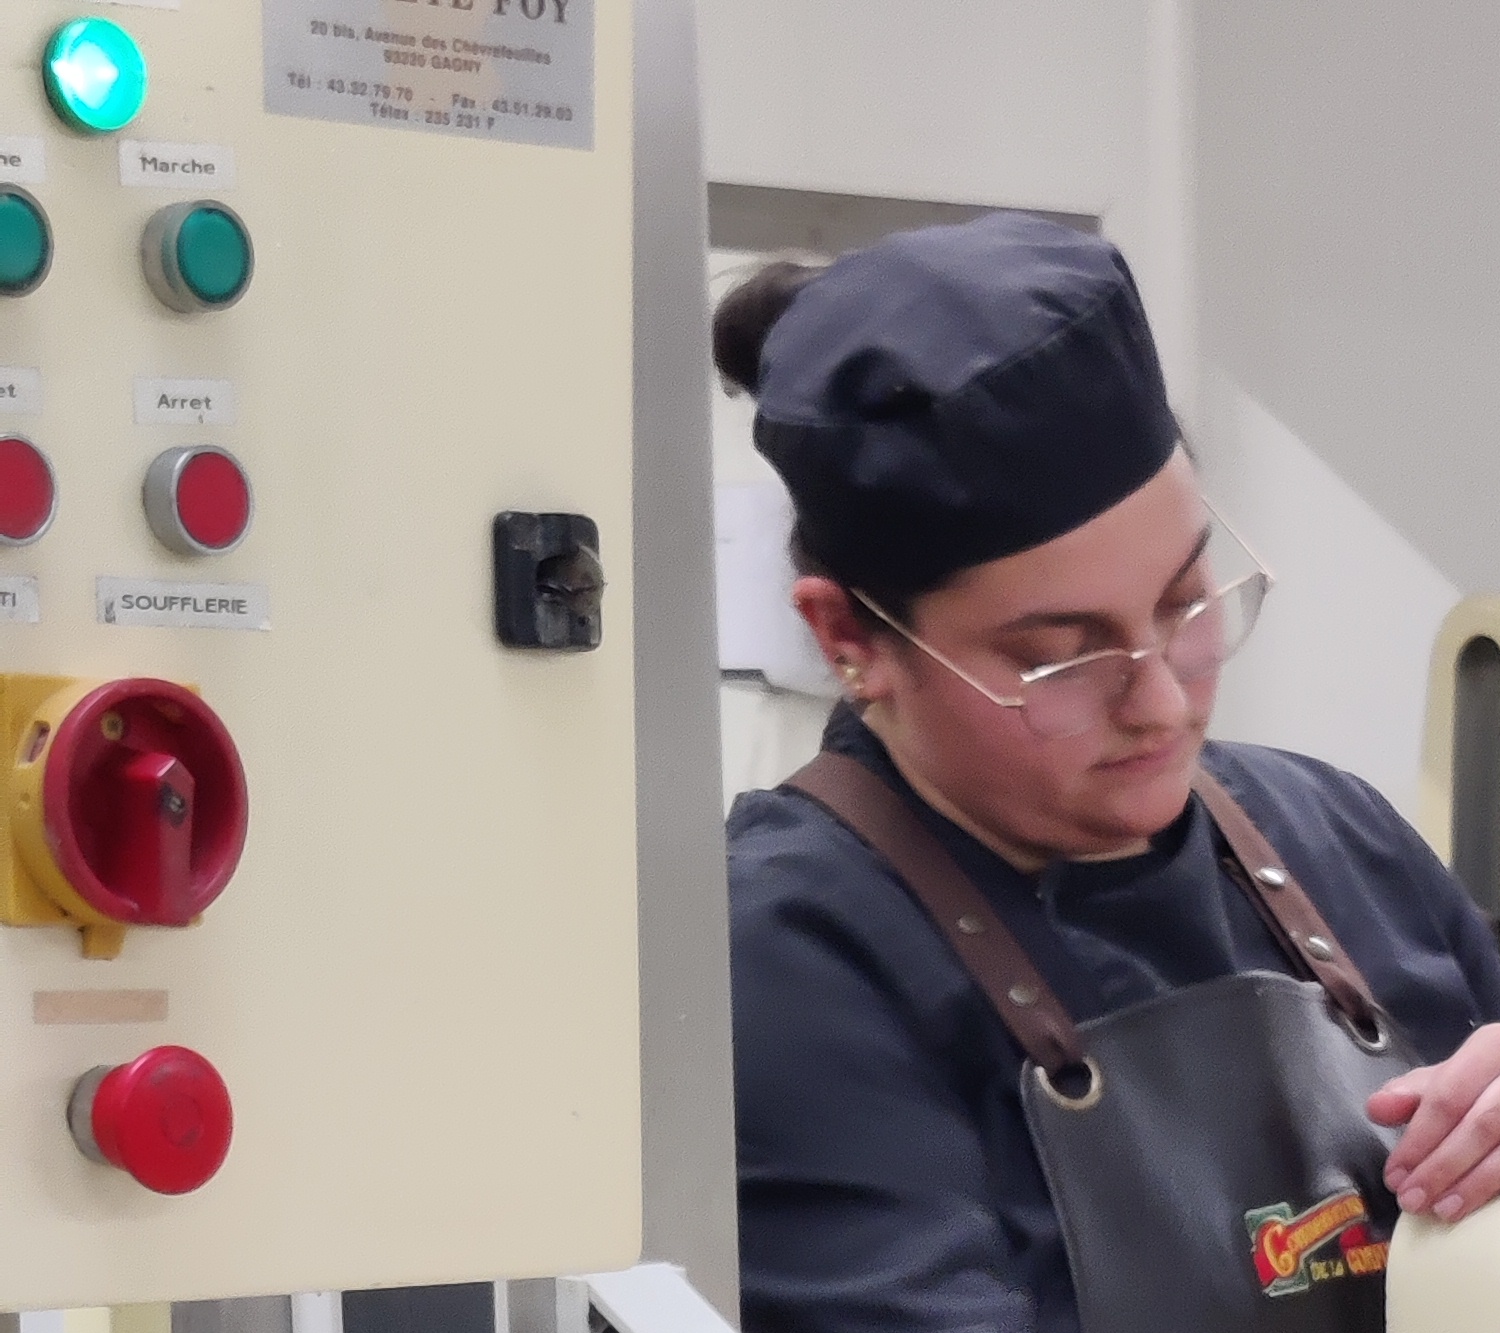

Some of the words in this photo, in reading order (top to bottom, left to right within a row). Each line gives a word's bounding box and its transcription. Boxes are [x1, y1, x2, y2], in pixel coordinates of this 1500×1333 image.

[364, 27, 416, 47] Avenue
[431, 55, 482, 73] GAGNY
[139, 155, 216, 175] Marche
[156, 393, 213, 411] Arret
[121, 594, 249, 615] SOUFFLERIE
